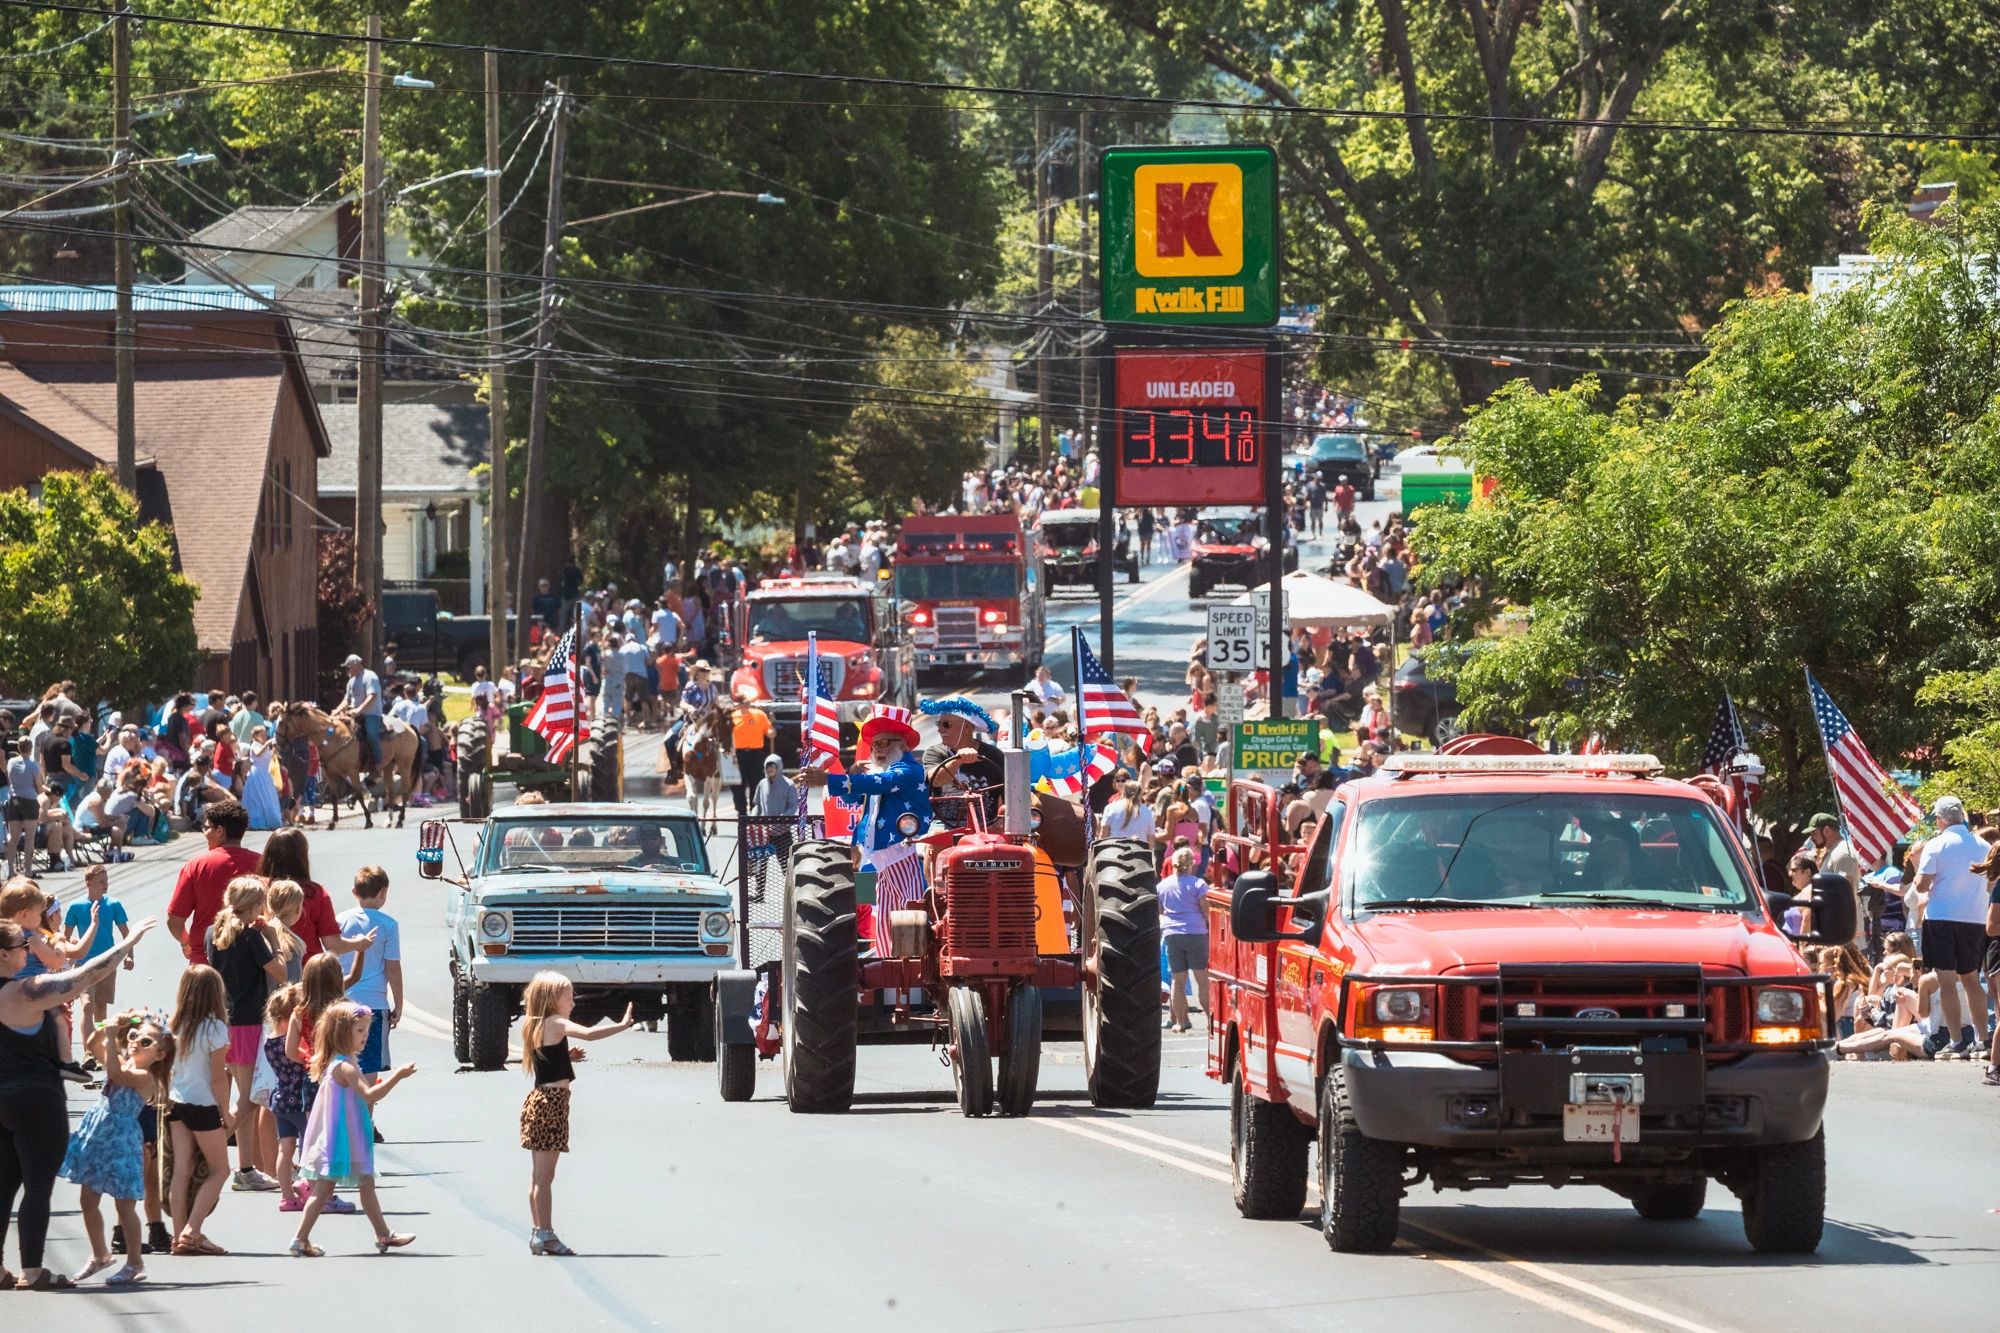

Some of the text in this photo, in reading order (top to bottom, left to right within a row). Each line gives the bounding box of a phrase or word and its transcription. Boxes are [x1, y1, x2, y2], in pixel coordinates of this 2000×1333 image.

[1155, 182, 1224, 258] K
[1136, 286, 1244, 313] Kwik Fill
[1146, 381, 1236, 398] UNLEADED
[1212, 612, 1253, 624] SPEED
[1216, 626, 1247, 637] LIMIT
[1212, 639, 1251, 663] 35
